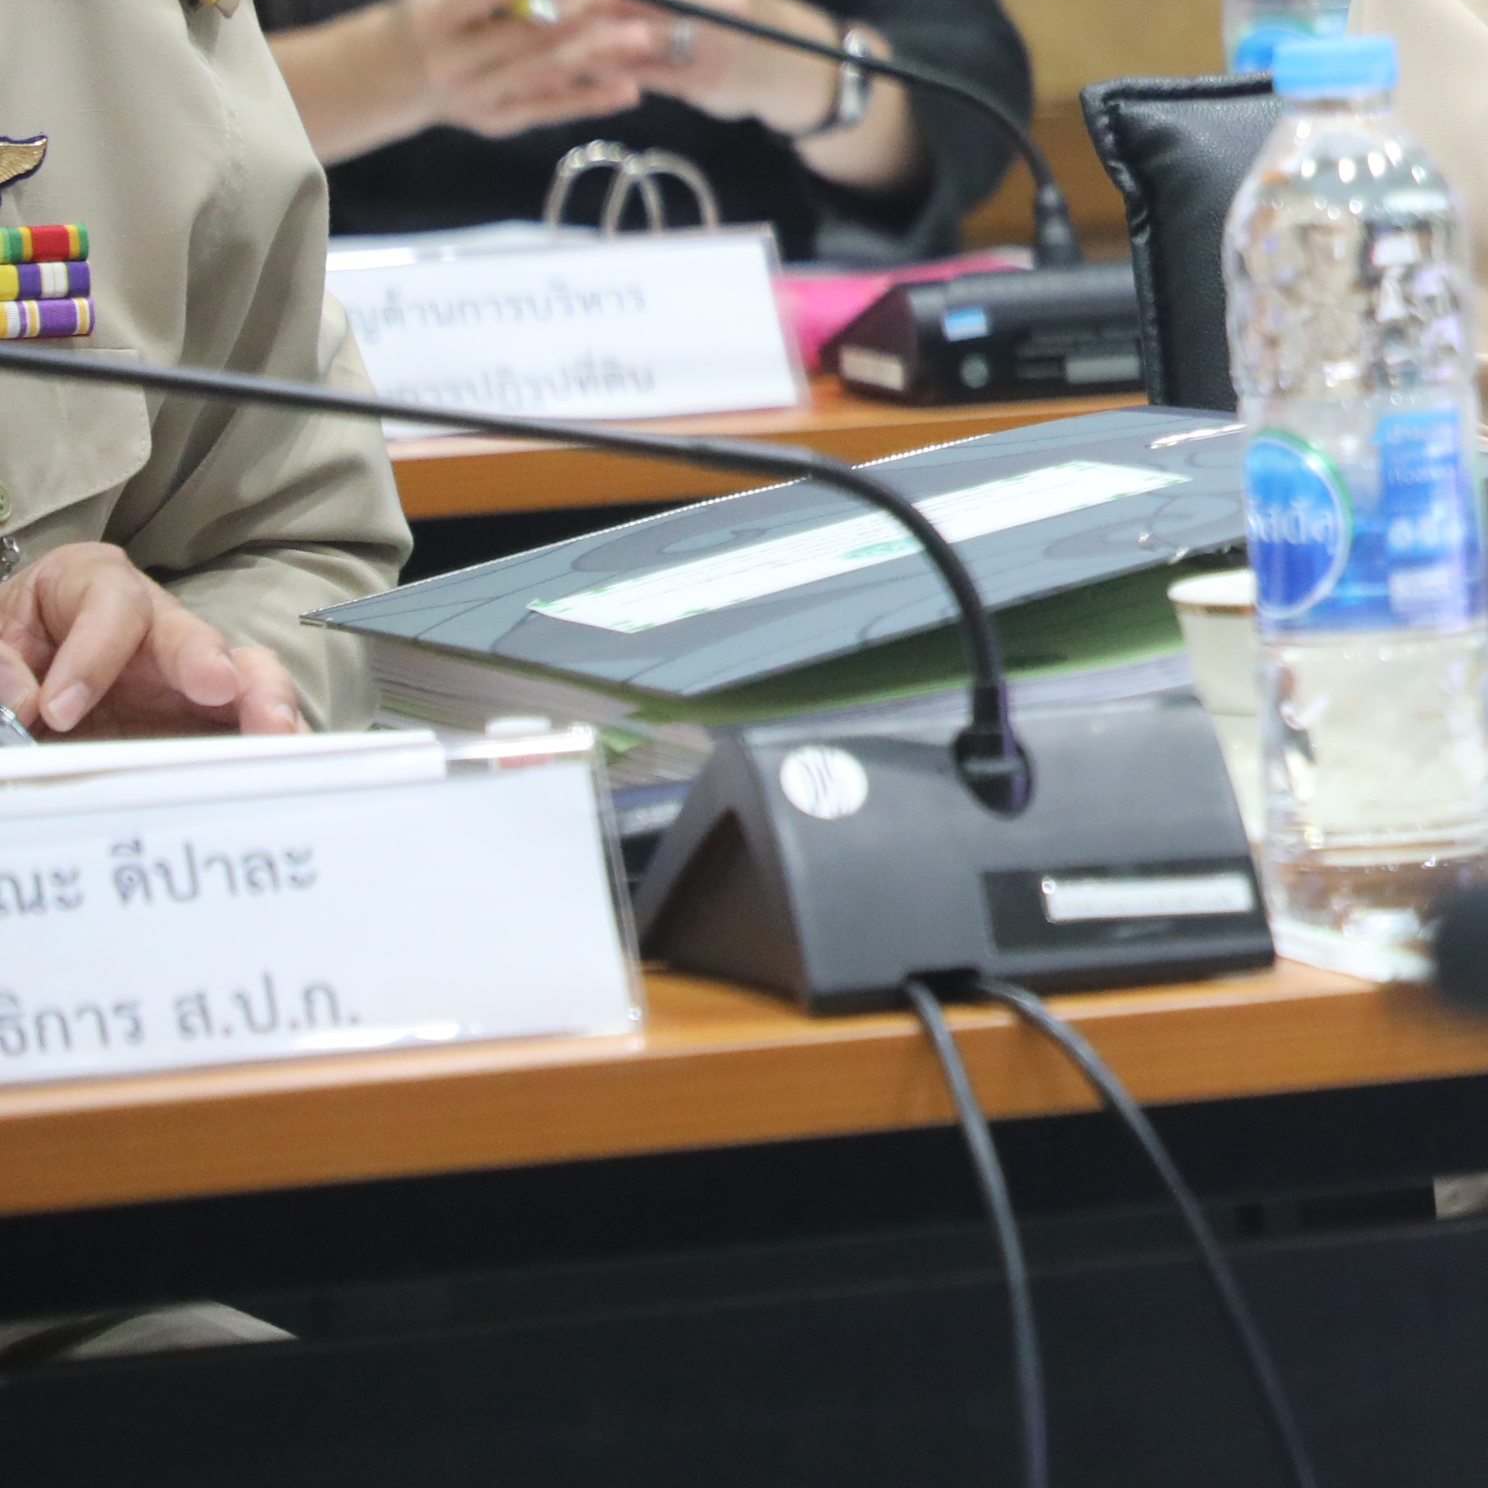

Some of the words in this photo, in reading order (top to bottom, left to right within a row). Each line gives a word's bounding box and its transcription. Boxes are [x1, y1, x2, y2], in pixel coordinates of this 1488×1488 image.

[109, 831, 320, 908] ดีปาละ
[172, 965, 364, 1043] ส.ป.ก.
